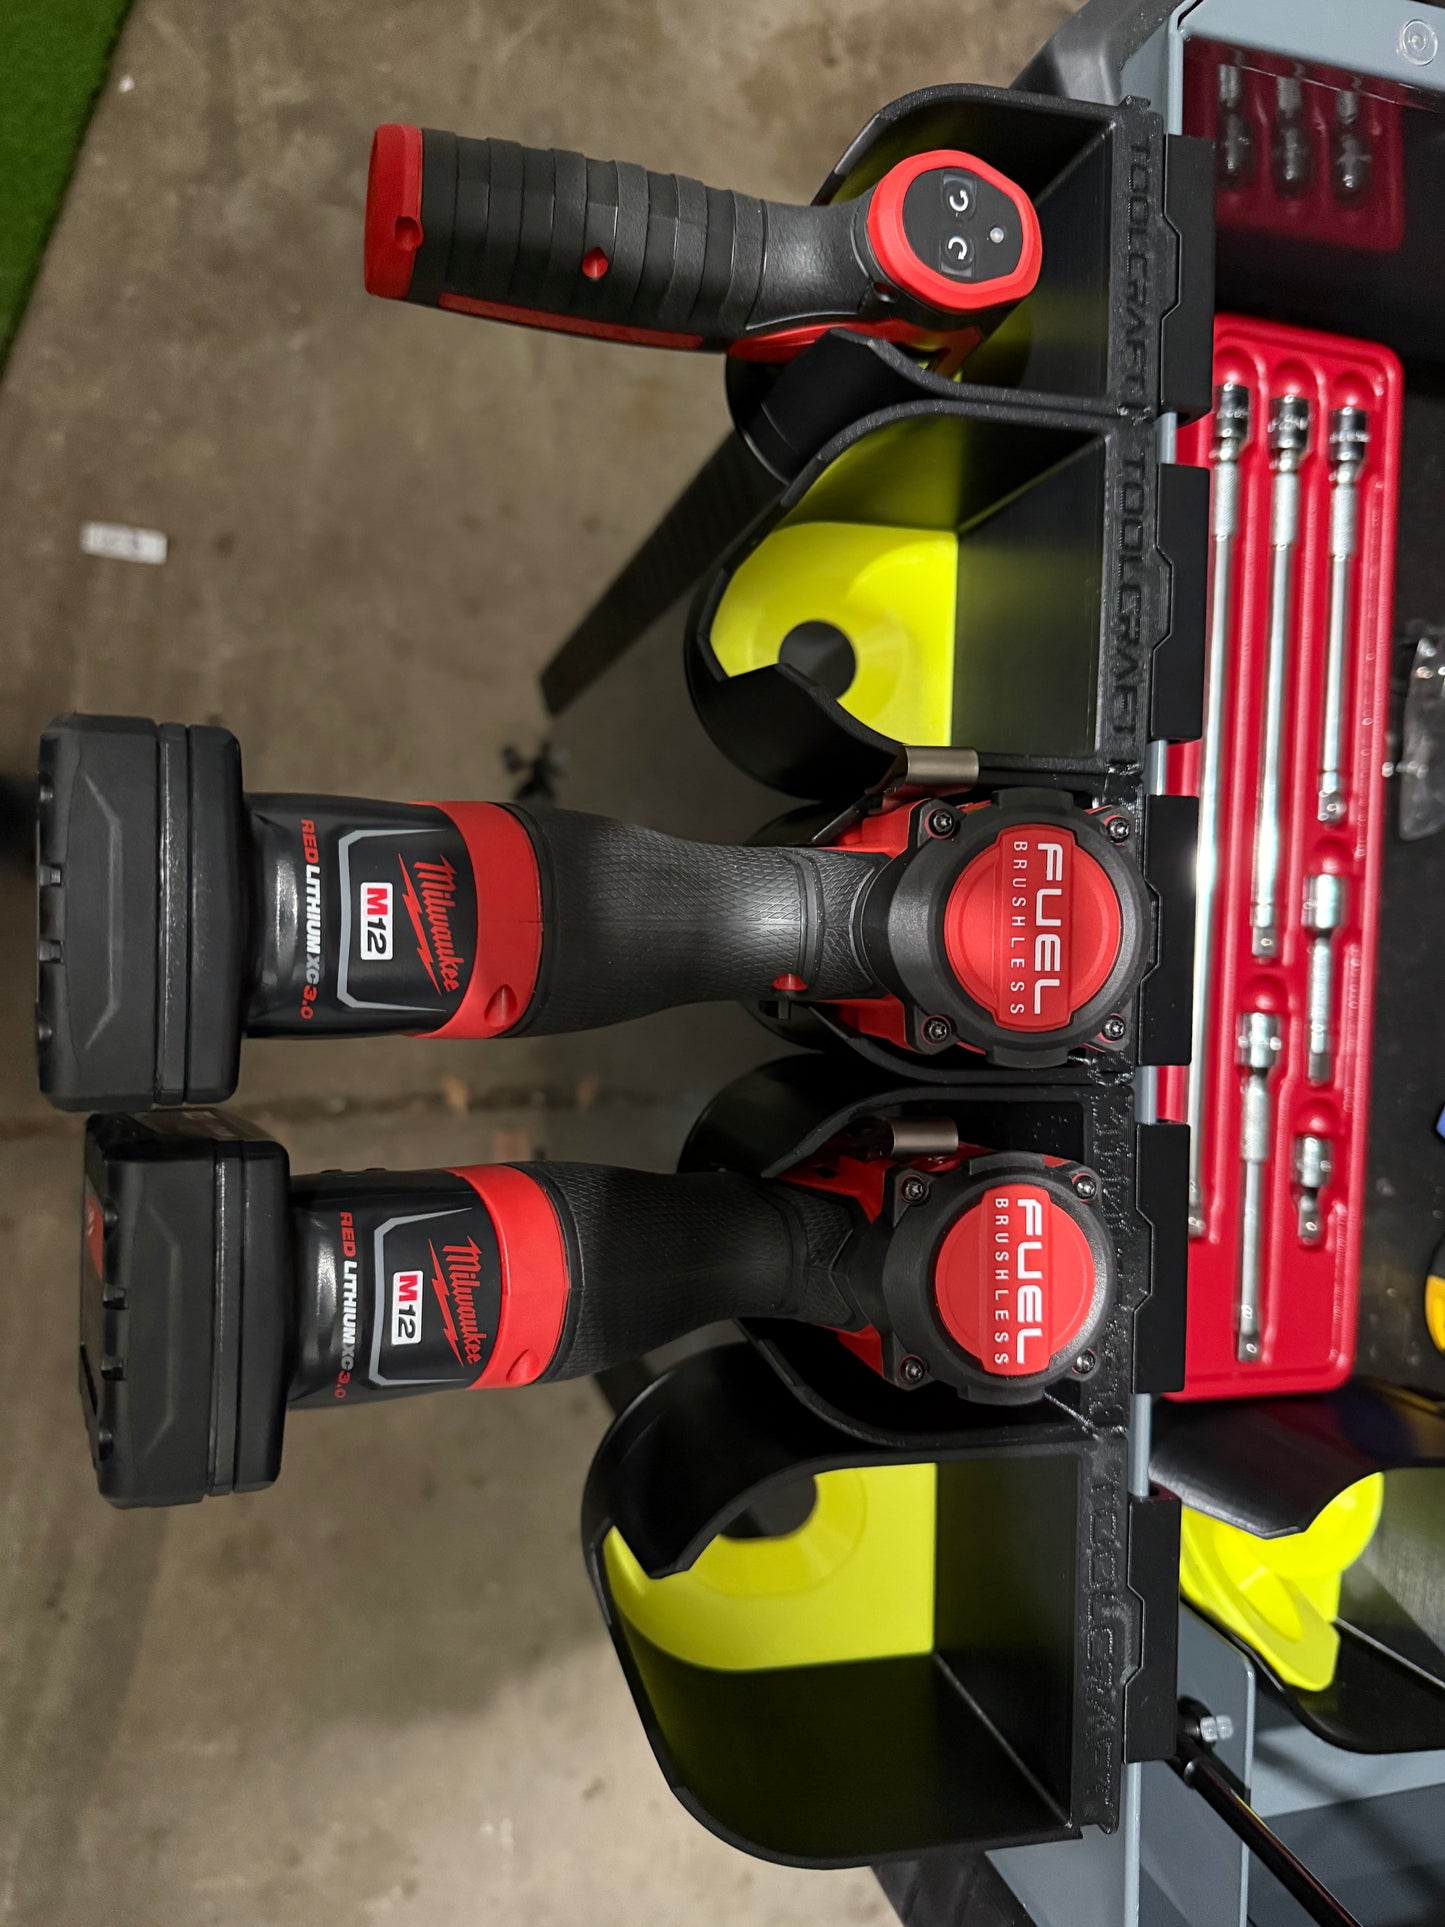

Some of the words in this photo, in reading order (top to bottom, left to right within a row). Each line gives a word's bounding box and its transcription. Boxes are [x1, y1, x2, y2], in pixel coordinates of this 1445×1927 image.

[1125, 143, 1150, 393] TOOLCRAFT
[1113, 453, 1146, 735] TOOLCRAFT
[366, 887, 389, 955] M12
[413, 853, 465, 992] Milwaukee
[1009, 841, 1028, 1015] BRUSHLESS
[1033, 842, 1064, 1015] FUEL
[397, 1273, 419, 1340] M12
[441, 1234, 487, 1365] Milwaukee
[994, 1197, 1010, 1365] BRUSHLESS
[1016, 1198, 1043, 1366] FUEL
